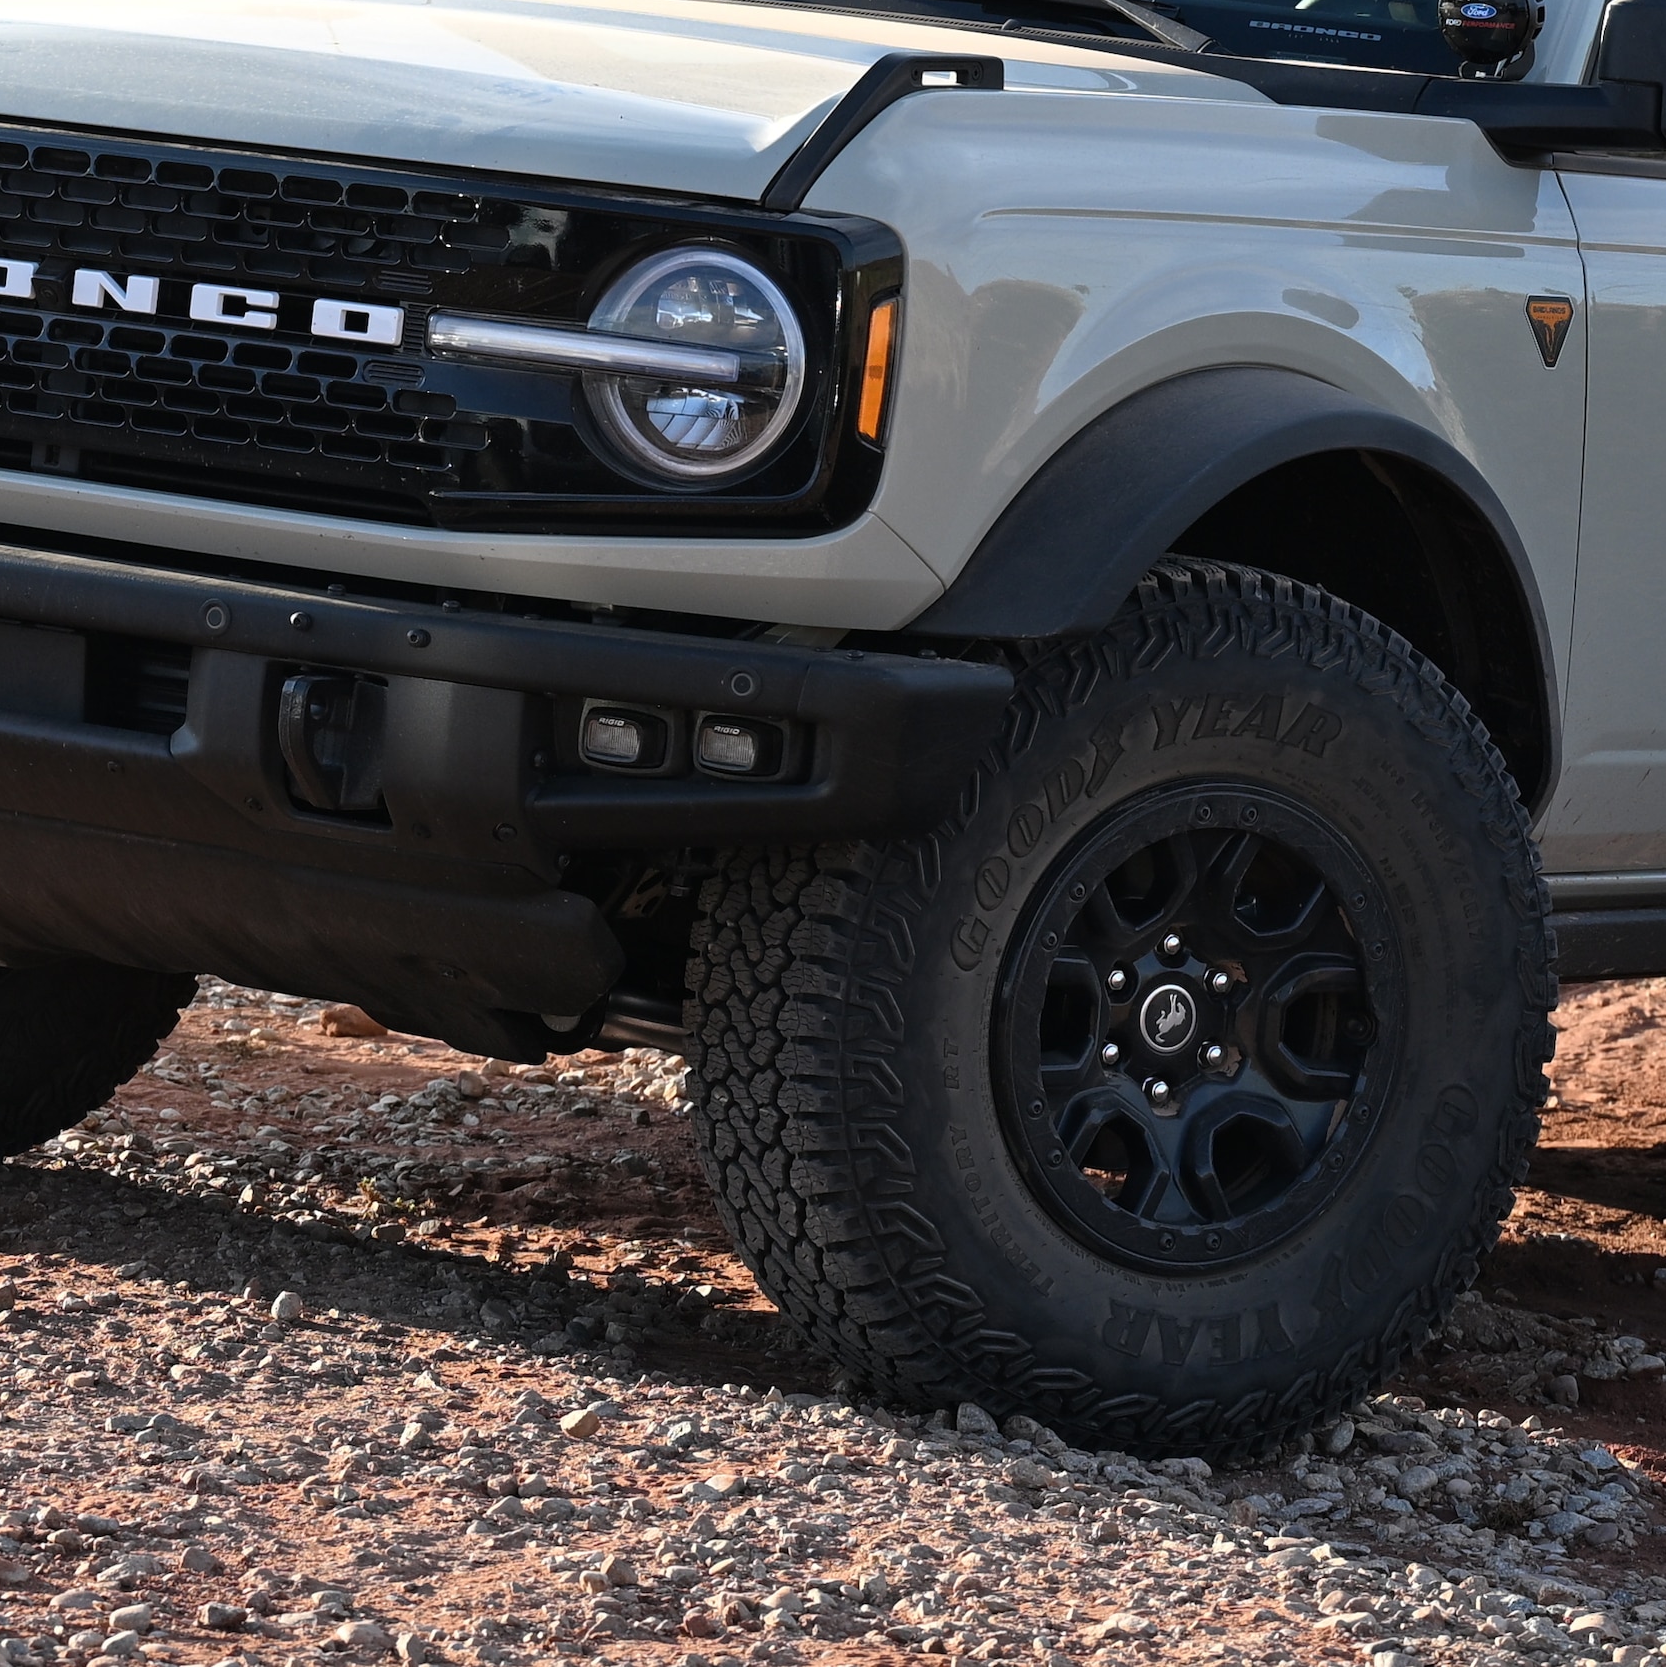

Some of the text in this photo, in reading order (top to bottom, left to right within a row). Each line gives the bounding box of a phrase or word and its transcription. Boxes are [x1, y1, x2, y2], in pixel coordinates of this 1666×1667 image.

[1465, 4, 1491, 17] Ford
[598, 717, 626, 727] RIGID
[713, 725, 741, 735] RIGID
